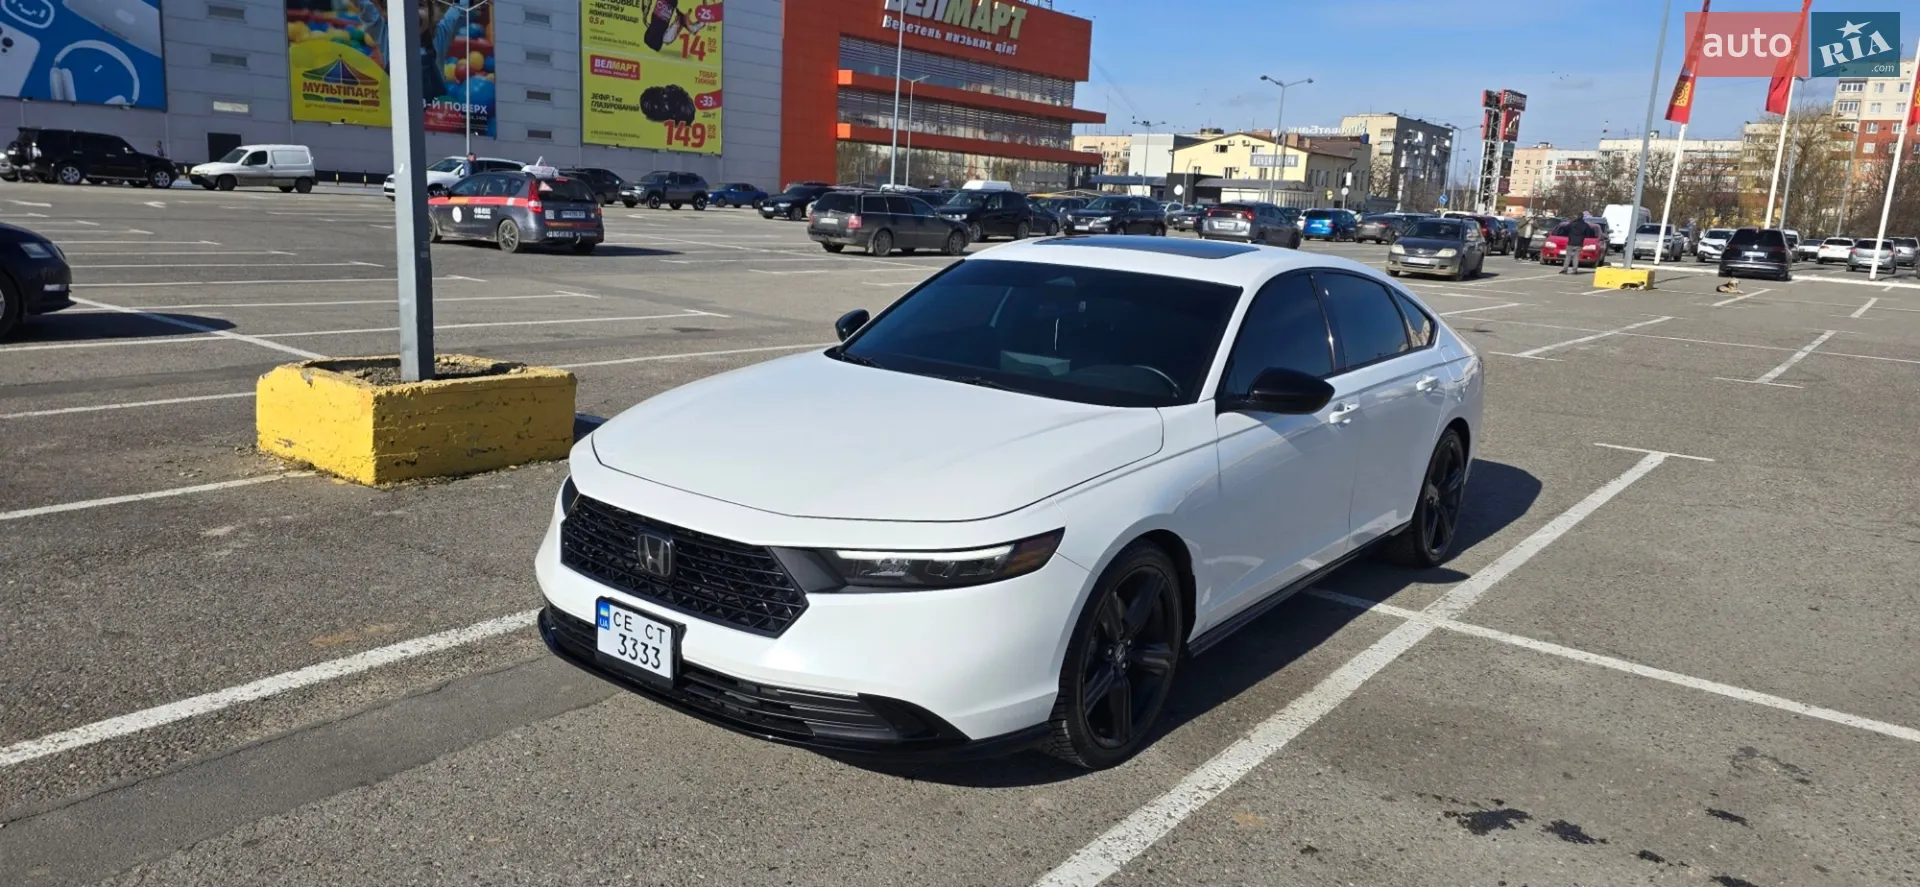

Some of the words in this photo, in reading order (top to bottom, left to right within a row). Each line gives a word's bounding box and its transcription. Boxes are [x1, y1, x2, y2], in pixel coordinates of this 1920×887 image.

[679, 33, 706, 61] 14
[945, 31, 992, 50] низьких
[594, 58, 638, 73] ВЕЛМАРТ
[302, 81, 379, 99] МУЛЬТІПАРК
[664, 119, 706, 148] 149
[600, 618, 609, 628] UA
[613, 612, 633, 632] CE
[645, 624, 666, 644] CT
[617, 633, 661, 669] 3333
